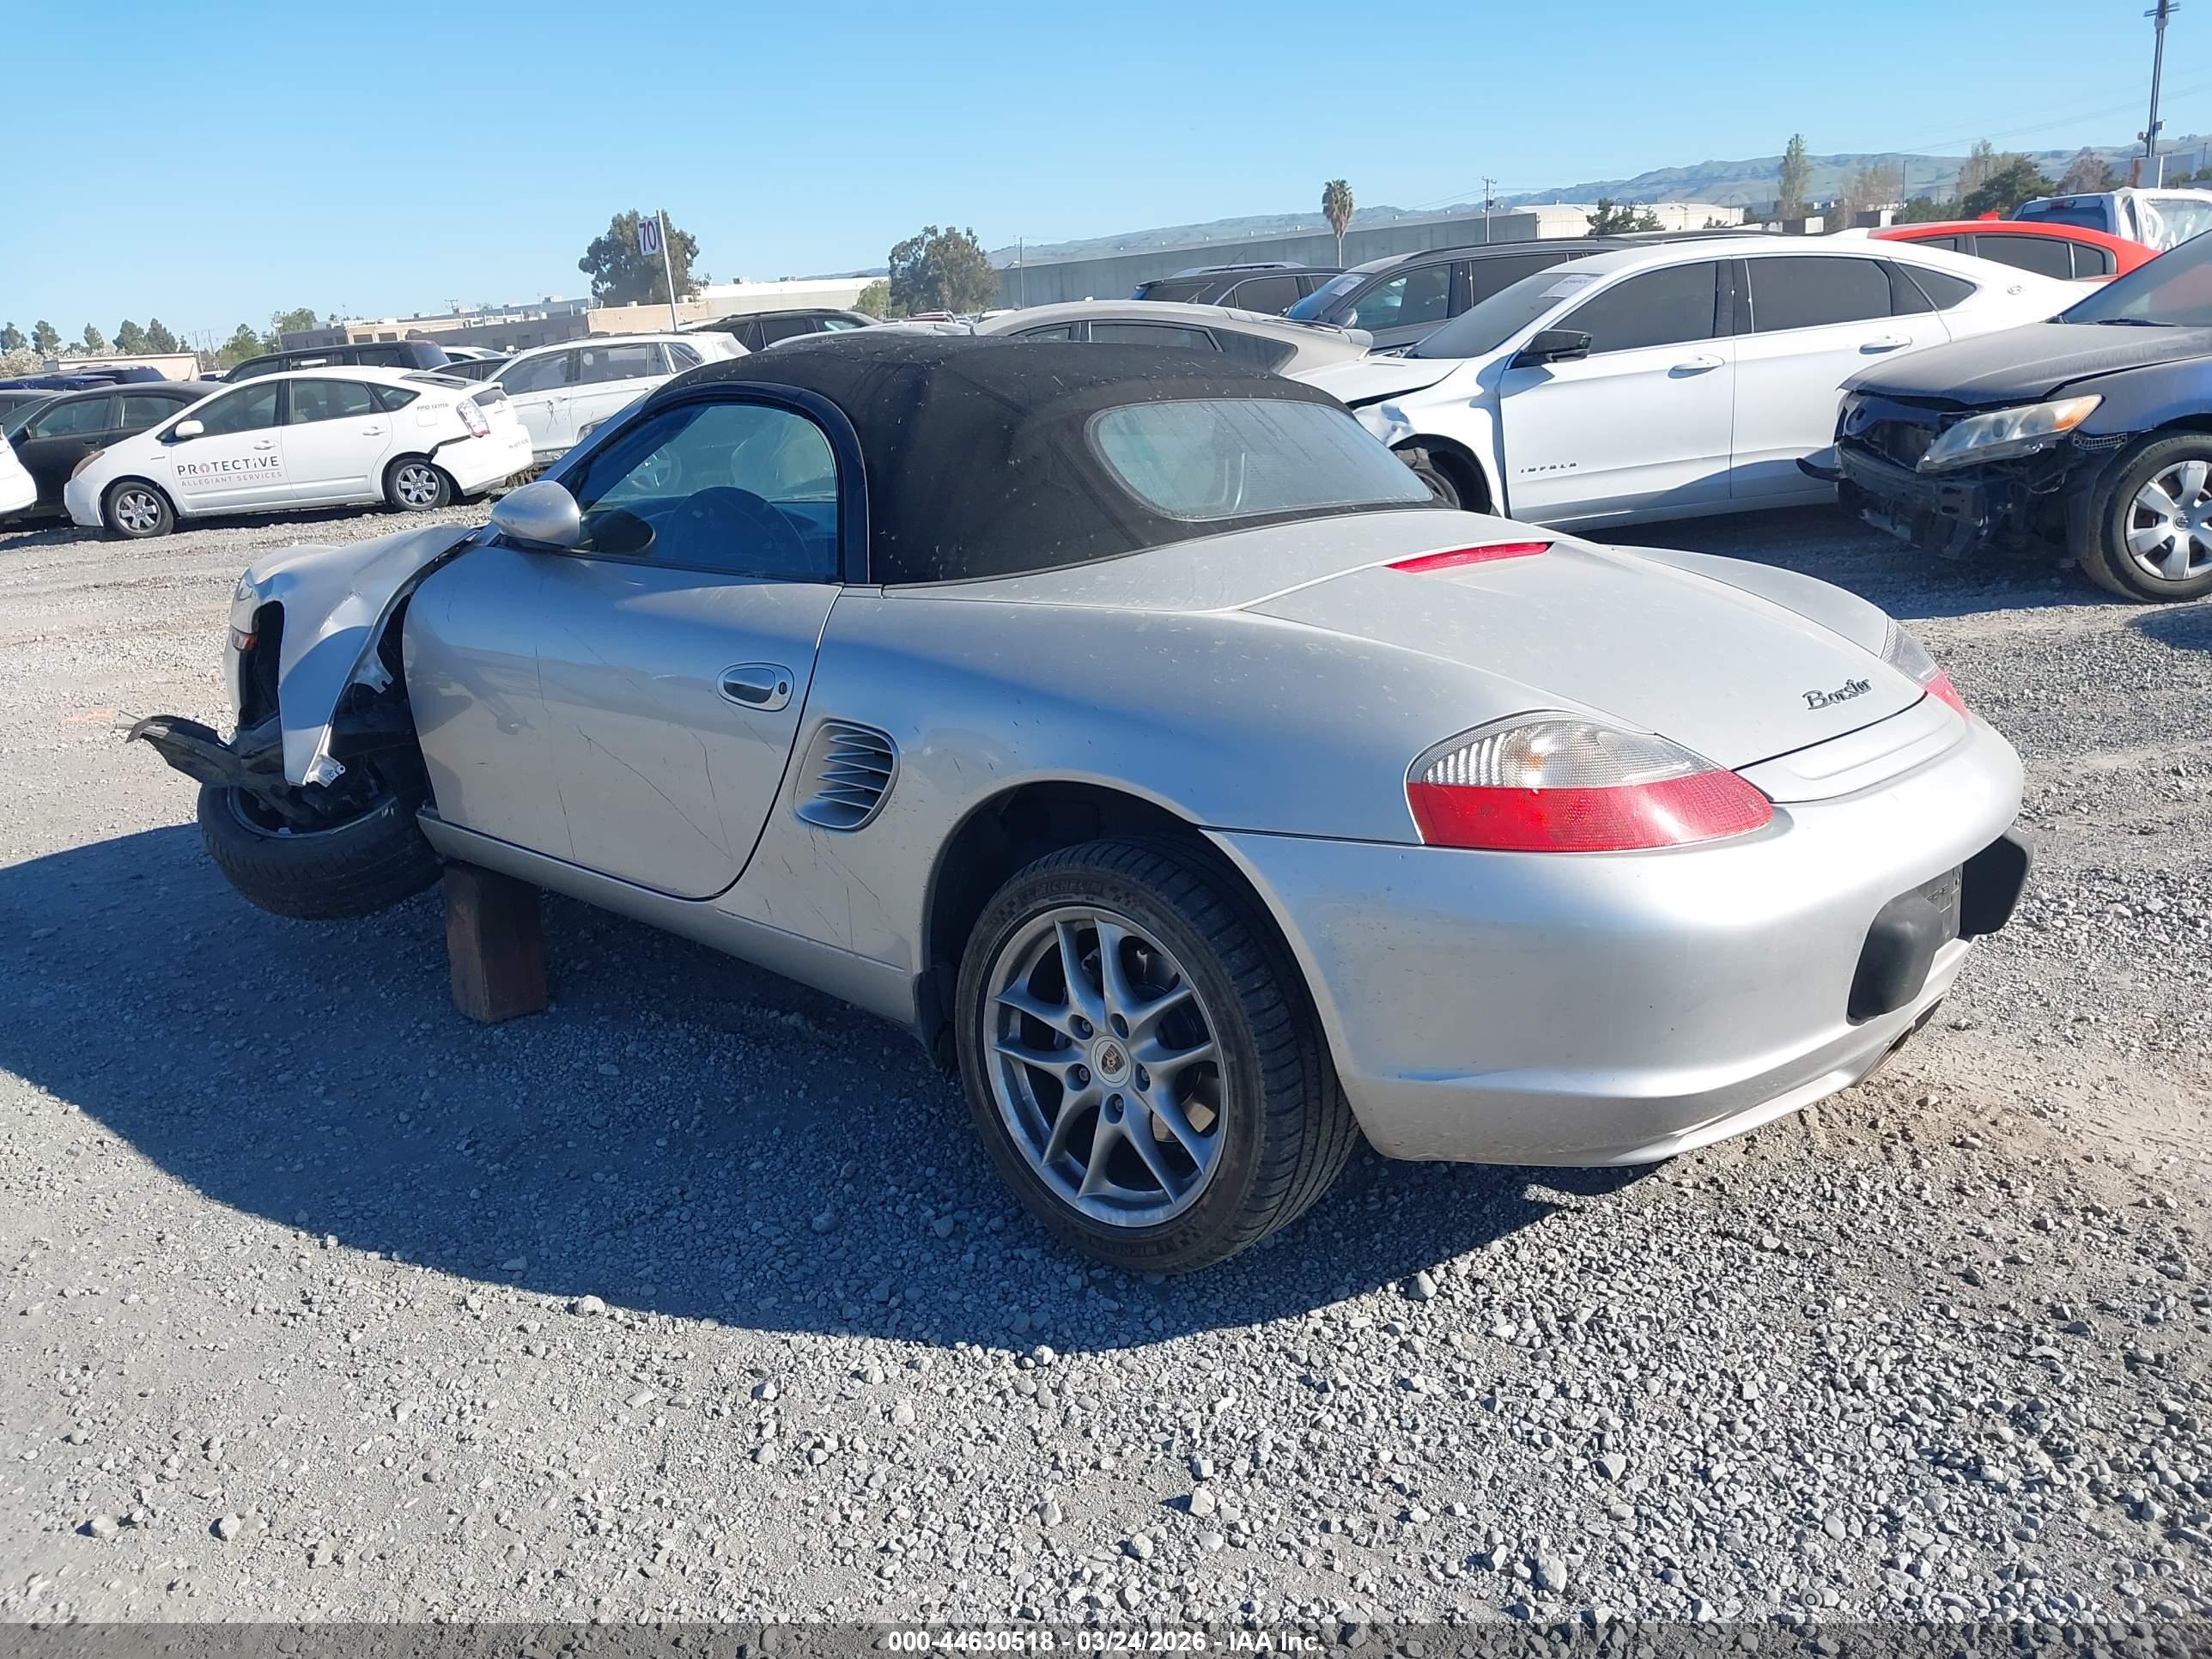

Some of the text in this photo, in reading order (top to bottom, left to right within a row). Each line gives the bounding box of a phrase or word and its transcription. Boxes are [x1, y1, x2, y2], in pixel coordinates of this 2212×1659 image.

[638, 220, 657, 251] 70
[181, 471, 283, 487] ALLEGIANT SERVICES
[1520, 462, 1577, 473] IMPALA
[1802, 678, 1872, 710] Boxster
